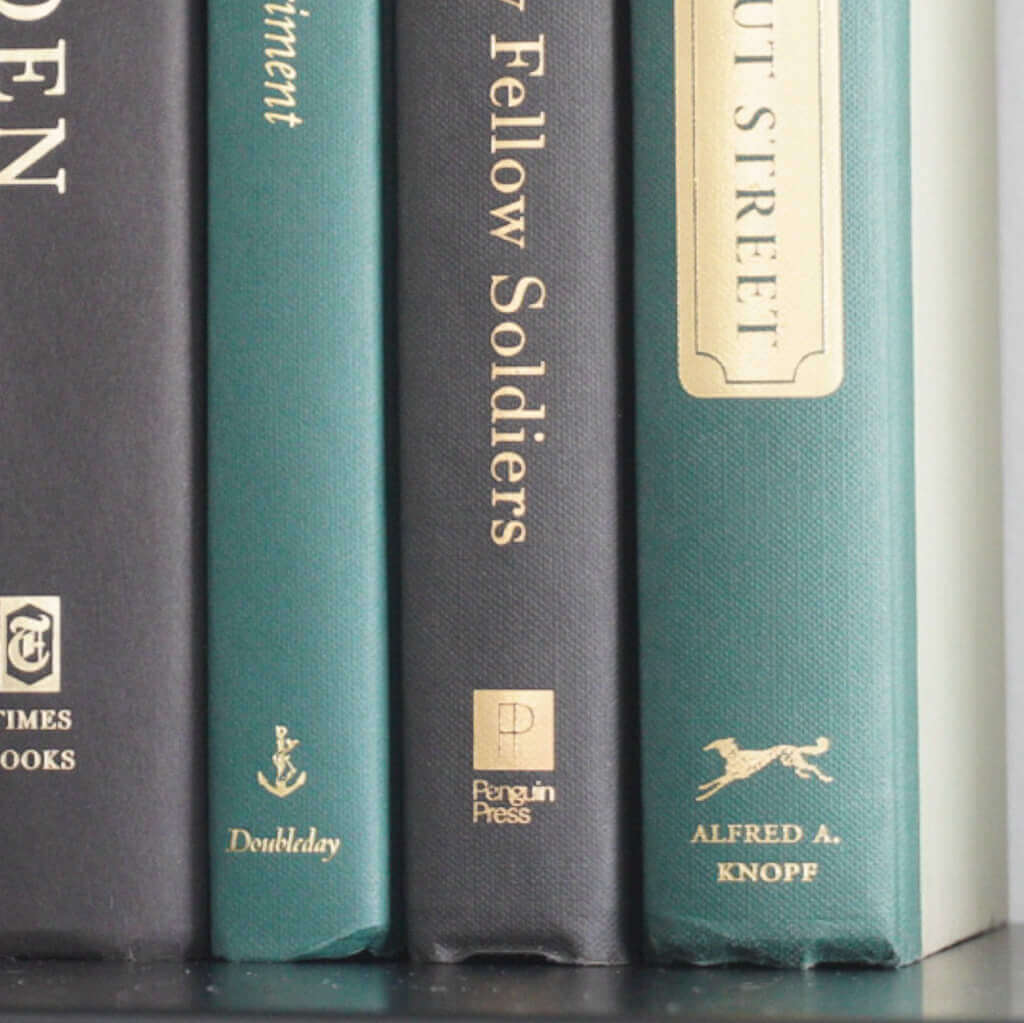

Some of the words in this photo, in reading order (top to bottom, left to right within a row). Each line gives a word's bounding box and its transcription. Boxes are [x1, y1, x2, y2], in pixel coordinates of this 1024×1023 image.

[489, 33, 546, 249] Fellow
[734, 105, 779, 349] STREET
[490, 275, 546, 545] Soldiers
[472, 779, 556, 805] Penguin
[472, 803, 532, 824] Press
[231, 826, 341, 863] Doubleday
[691, 823, 804, 844] ALFRED
[812, 823, 842, 845] A.
[717, 862, 819, 883] KNOPF
